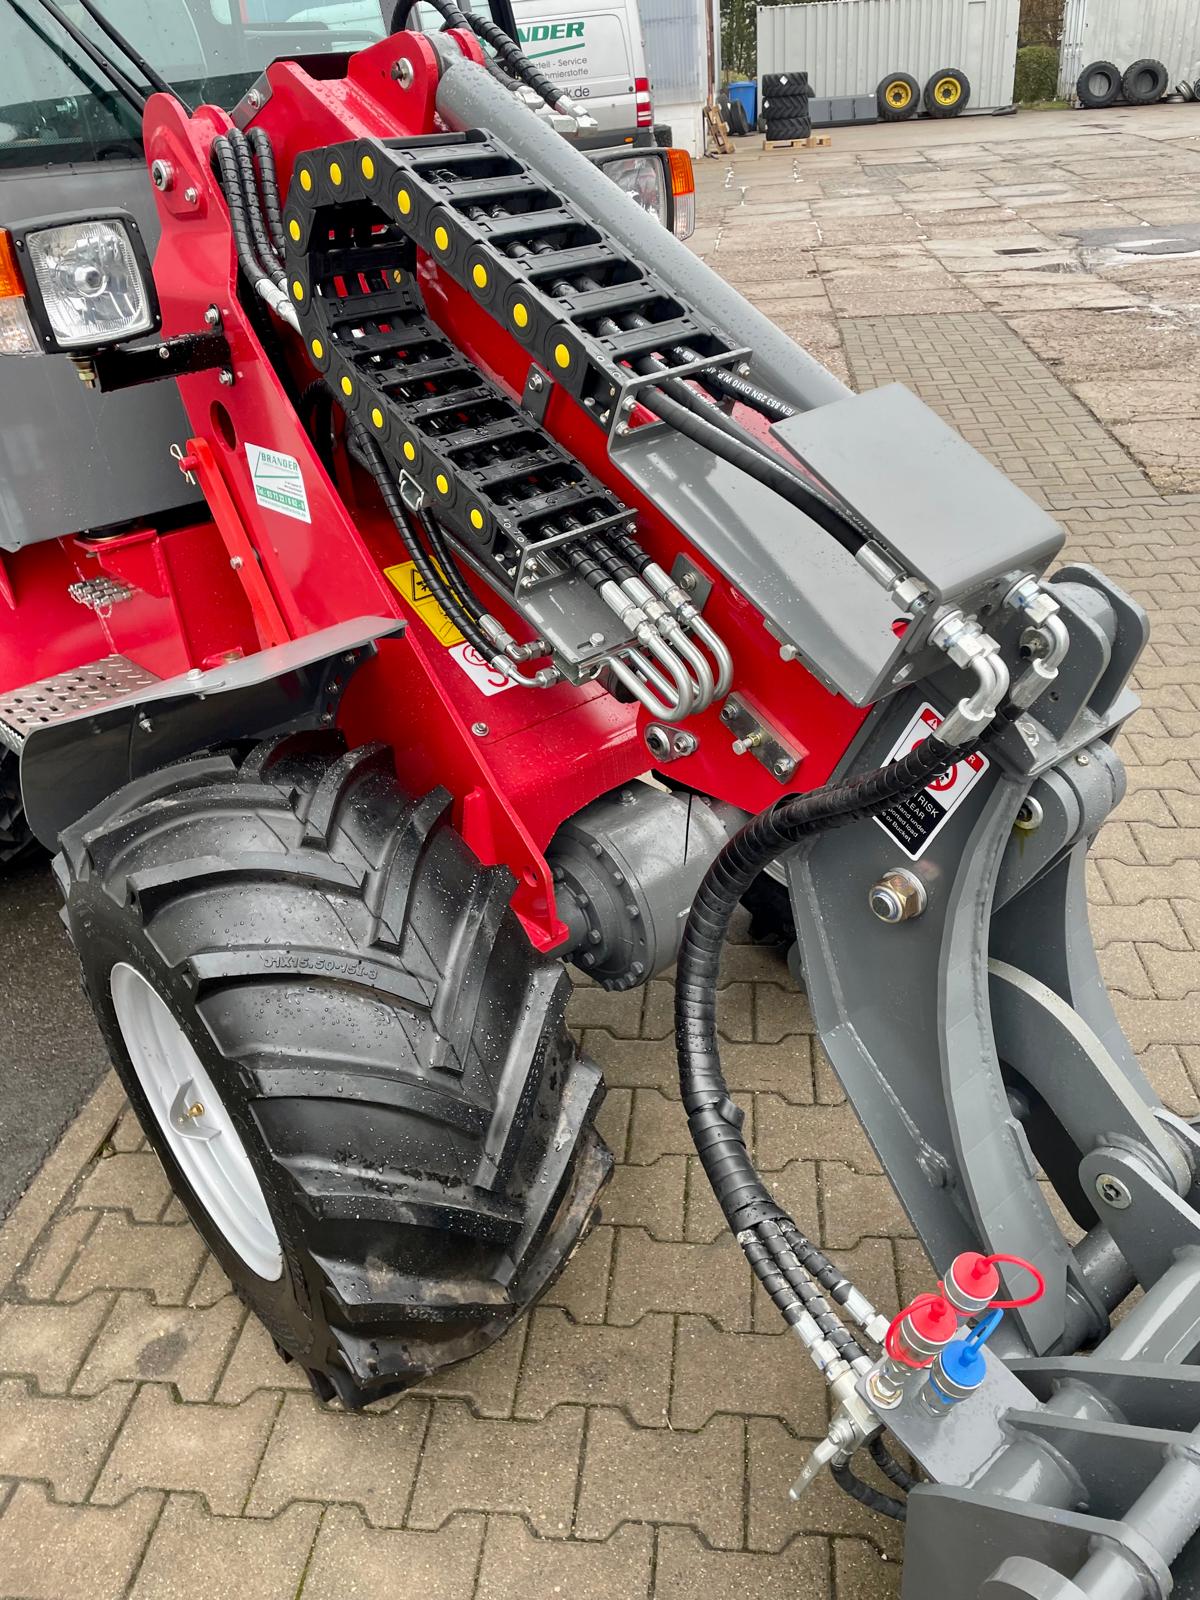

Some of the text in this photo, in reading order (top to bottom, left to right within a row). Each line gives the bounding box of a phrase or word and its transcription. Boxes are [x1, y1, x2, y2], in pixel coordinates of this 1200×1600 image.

[517, 22, 585, 42] NDER
[558, 58, 588, 67] Service
[544, 68, 588, 78] hmierstoffe
[732, 381, 752, 394] DN10
[751, 391, 768, 401] 2SN
[766, 400, 781, 410] 853
[261, 452, 298, 471] BRANDER
[905, 799, 925, 820] LEAR
[917, 795, 940, 818] RISK
[892, 820, 911, 842] Bucket
[905, 823, 919, 838] load
[910, 818, 927, 834] under
